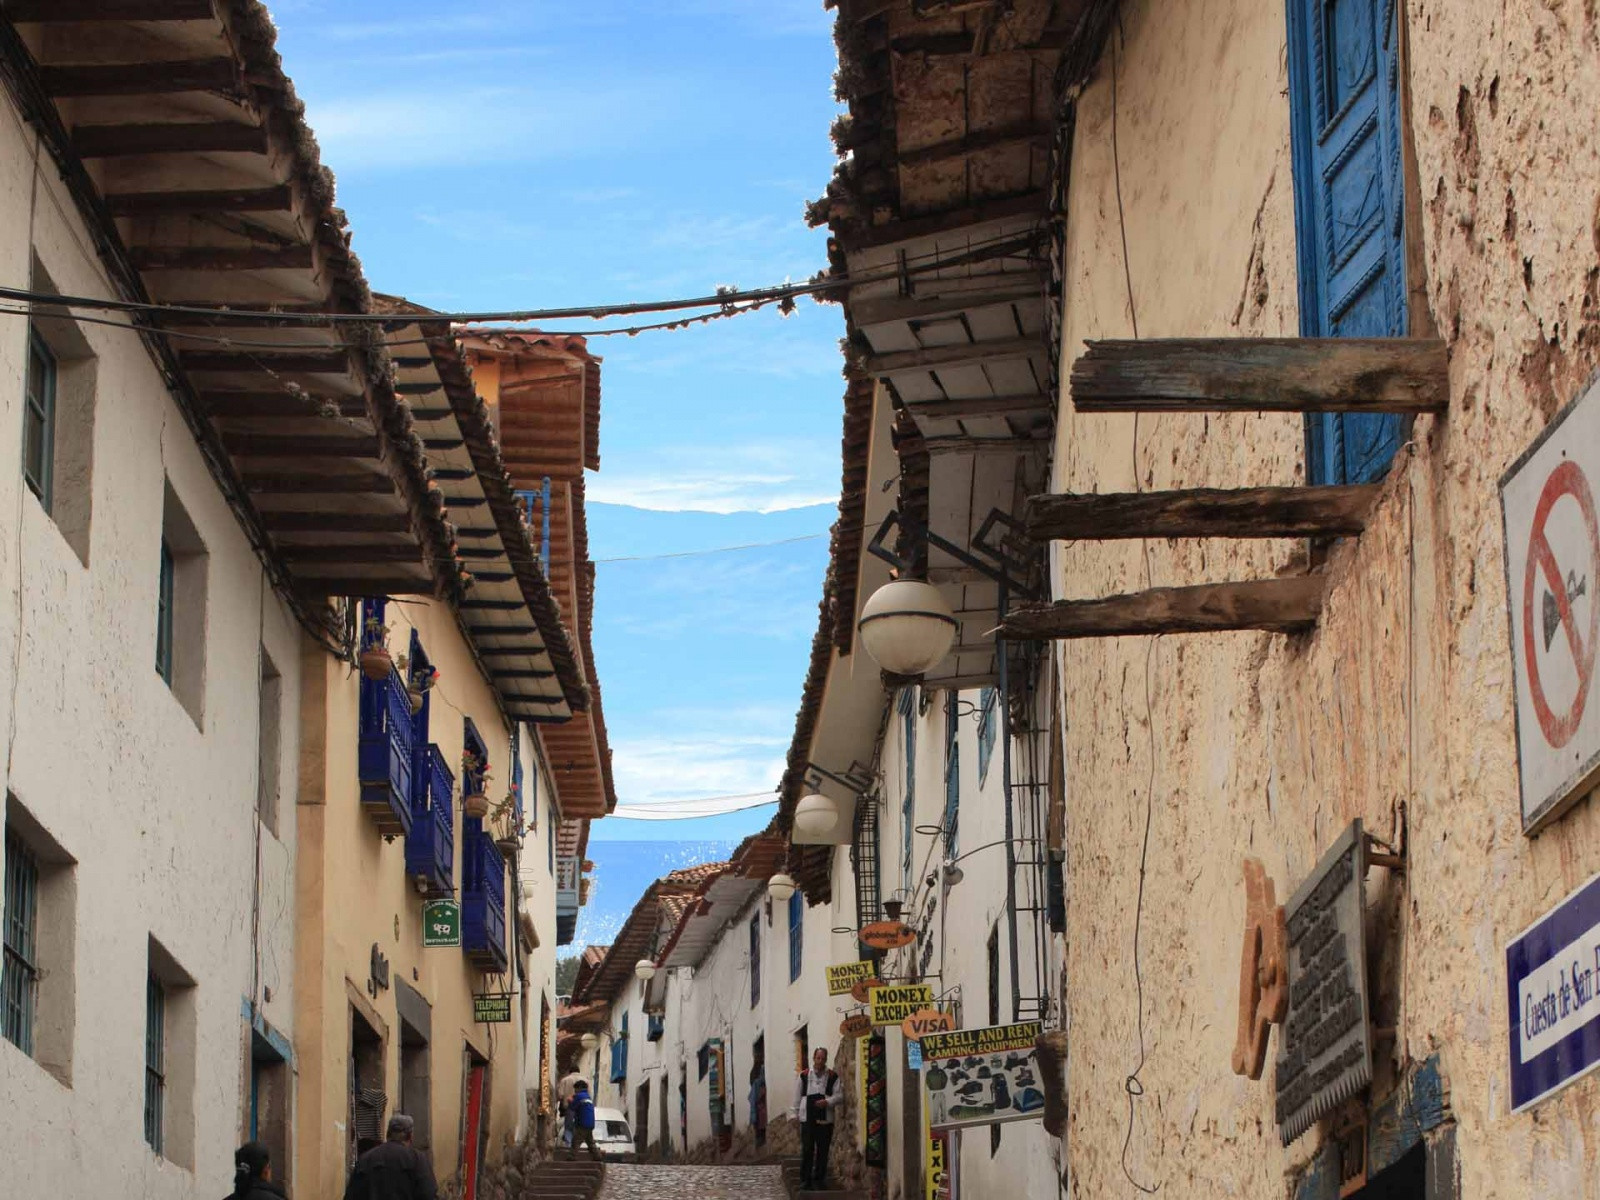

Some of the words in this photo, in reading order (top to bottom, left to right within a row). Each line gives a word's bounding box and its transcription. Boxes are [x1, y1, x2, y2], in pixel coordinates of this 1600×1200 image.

[830, 963, 869, 978] MONEY
[830, 974, 868, 990] EXCHAN
[876, 988, 928, 1003] MONEY
[1525, 981, 1557, 1040] Cuesta
[1559, 969, 1570, 1020] de
[1572, 961, 1592, 1011] San
[475, 1000, 508, 1010] TELEPHONE
[475, 1011, 509, 1020] INTERNET
[910, 1019, 949, 1033] VISA
[923, 1035, 944, 1050] WE
[946, 1031, 976, 1046] SELL
[978, 1027, 1005, 1043] AND
[1008, 1022, 1041, 1039] RENT
[927, 1044, 975, 1059] CAMPING
[978, 1038, 1036, 1053] EQUIPMENT
